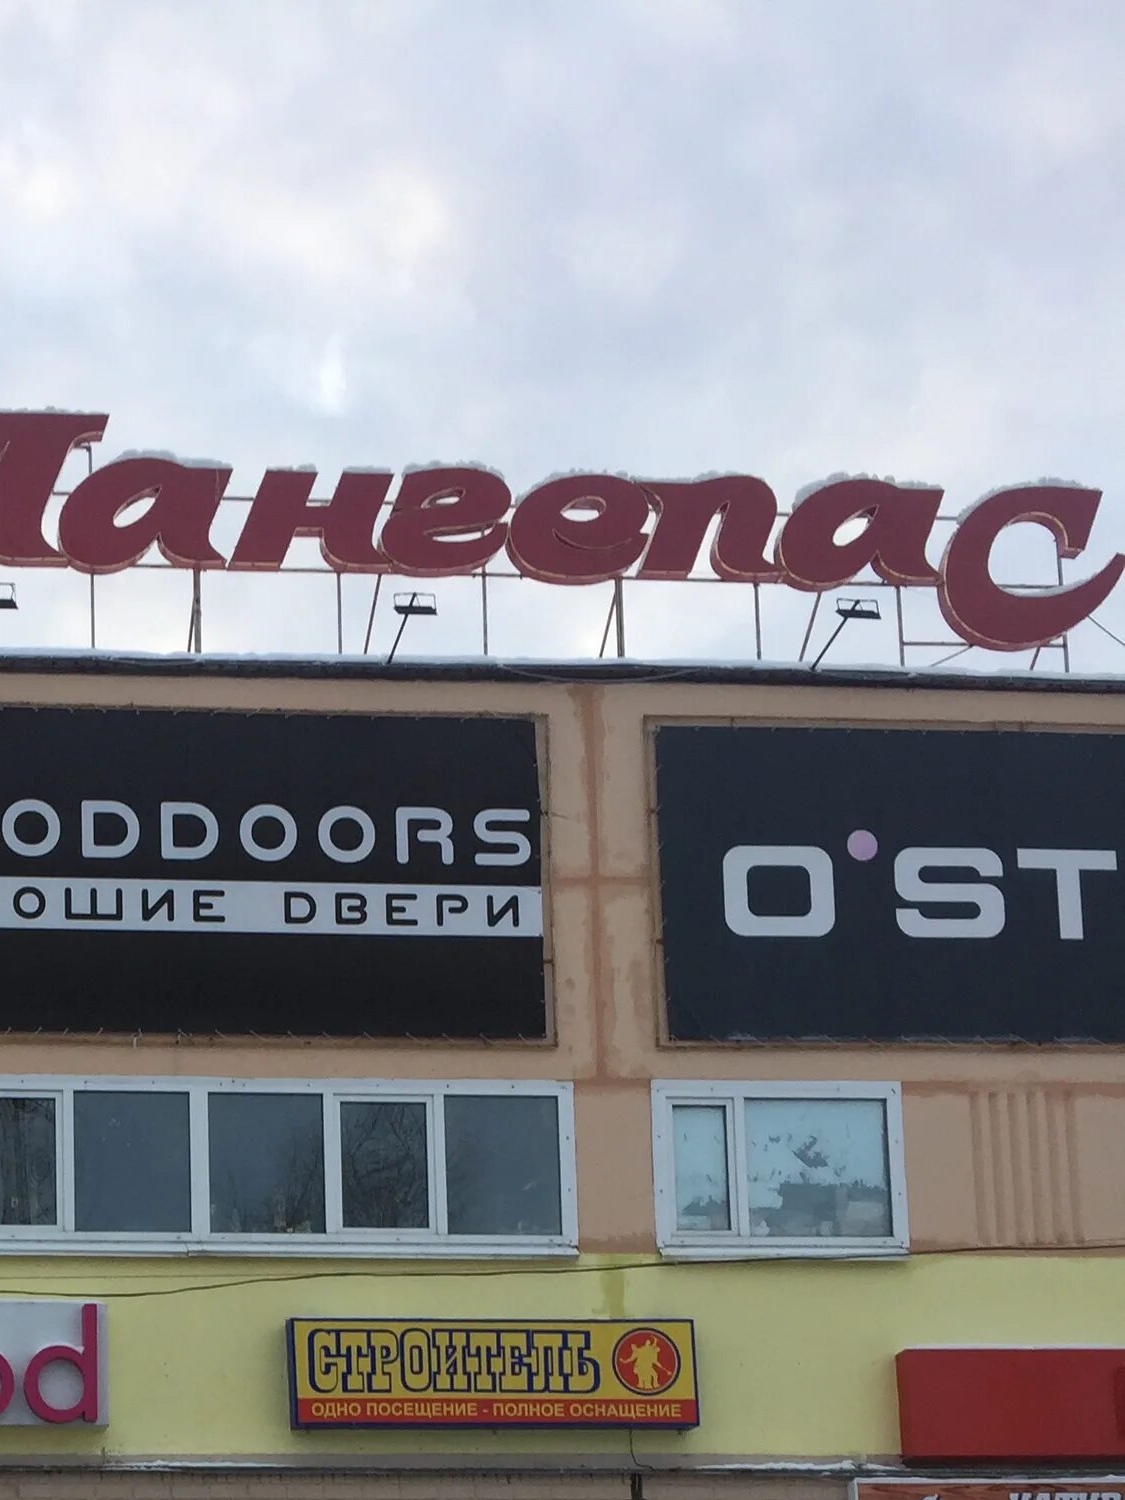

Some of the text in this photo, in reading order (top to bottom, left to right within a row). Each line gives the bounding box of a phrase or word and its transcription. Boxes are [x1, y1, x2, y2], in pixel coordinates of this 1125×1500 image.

[307, 1327, 601, 1395] СТРОИТЕЛЬ
[311, 1402, 361, 1418] ОДНО
[366, 1402, 477, 1418] ПОСЕЩЕНИЕ
[492, 1403, 565, 1417] ПОЛНОЕ
[569, 1403, 682, 1419] ОСНАЩЕНИЕ
